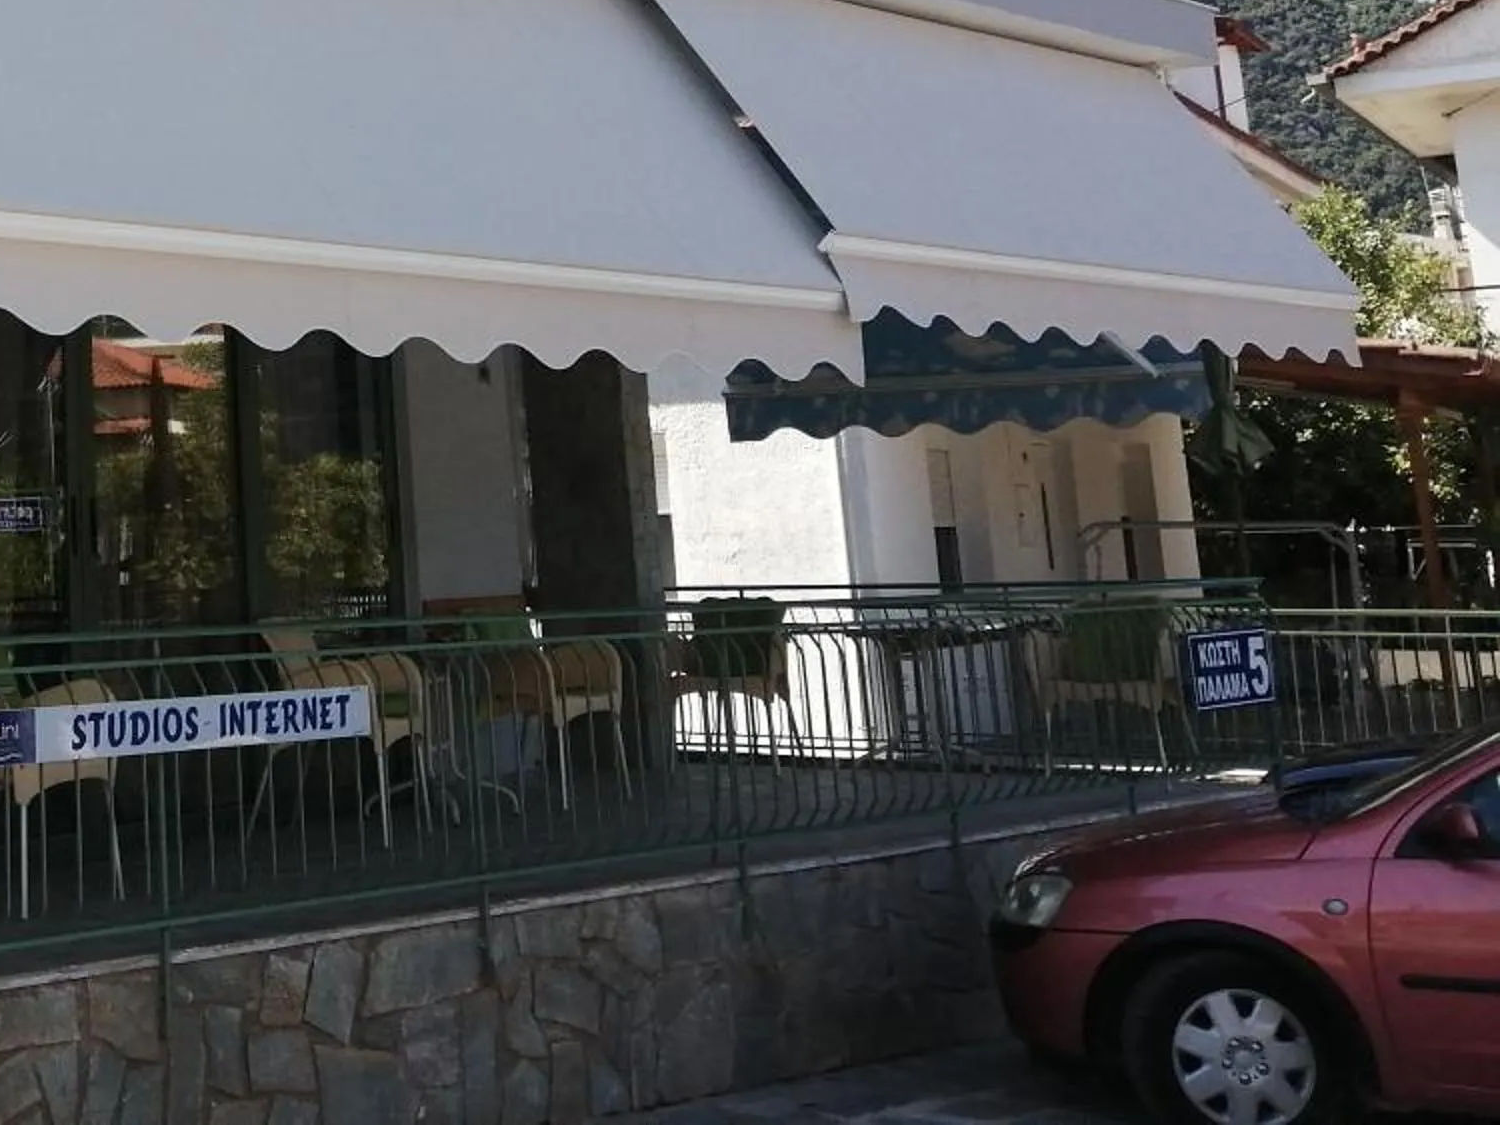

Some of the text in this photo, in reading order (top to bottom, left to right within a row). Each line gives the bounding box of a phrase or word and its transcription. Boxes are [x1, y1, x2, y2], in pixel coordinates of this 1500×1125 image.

[1248, 636, 1269, 695] 5
[71, 695, 350, 751] STUDIOS INTERNET
